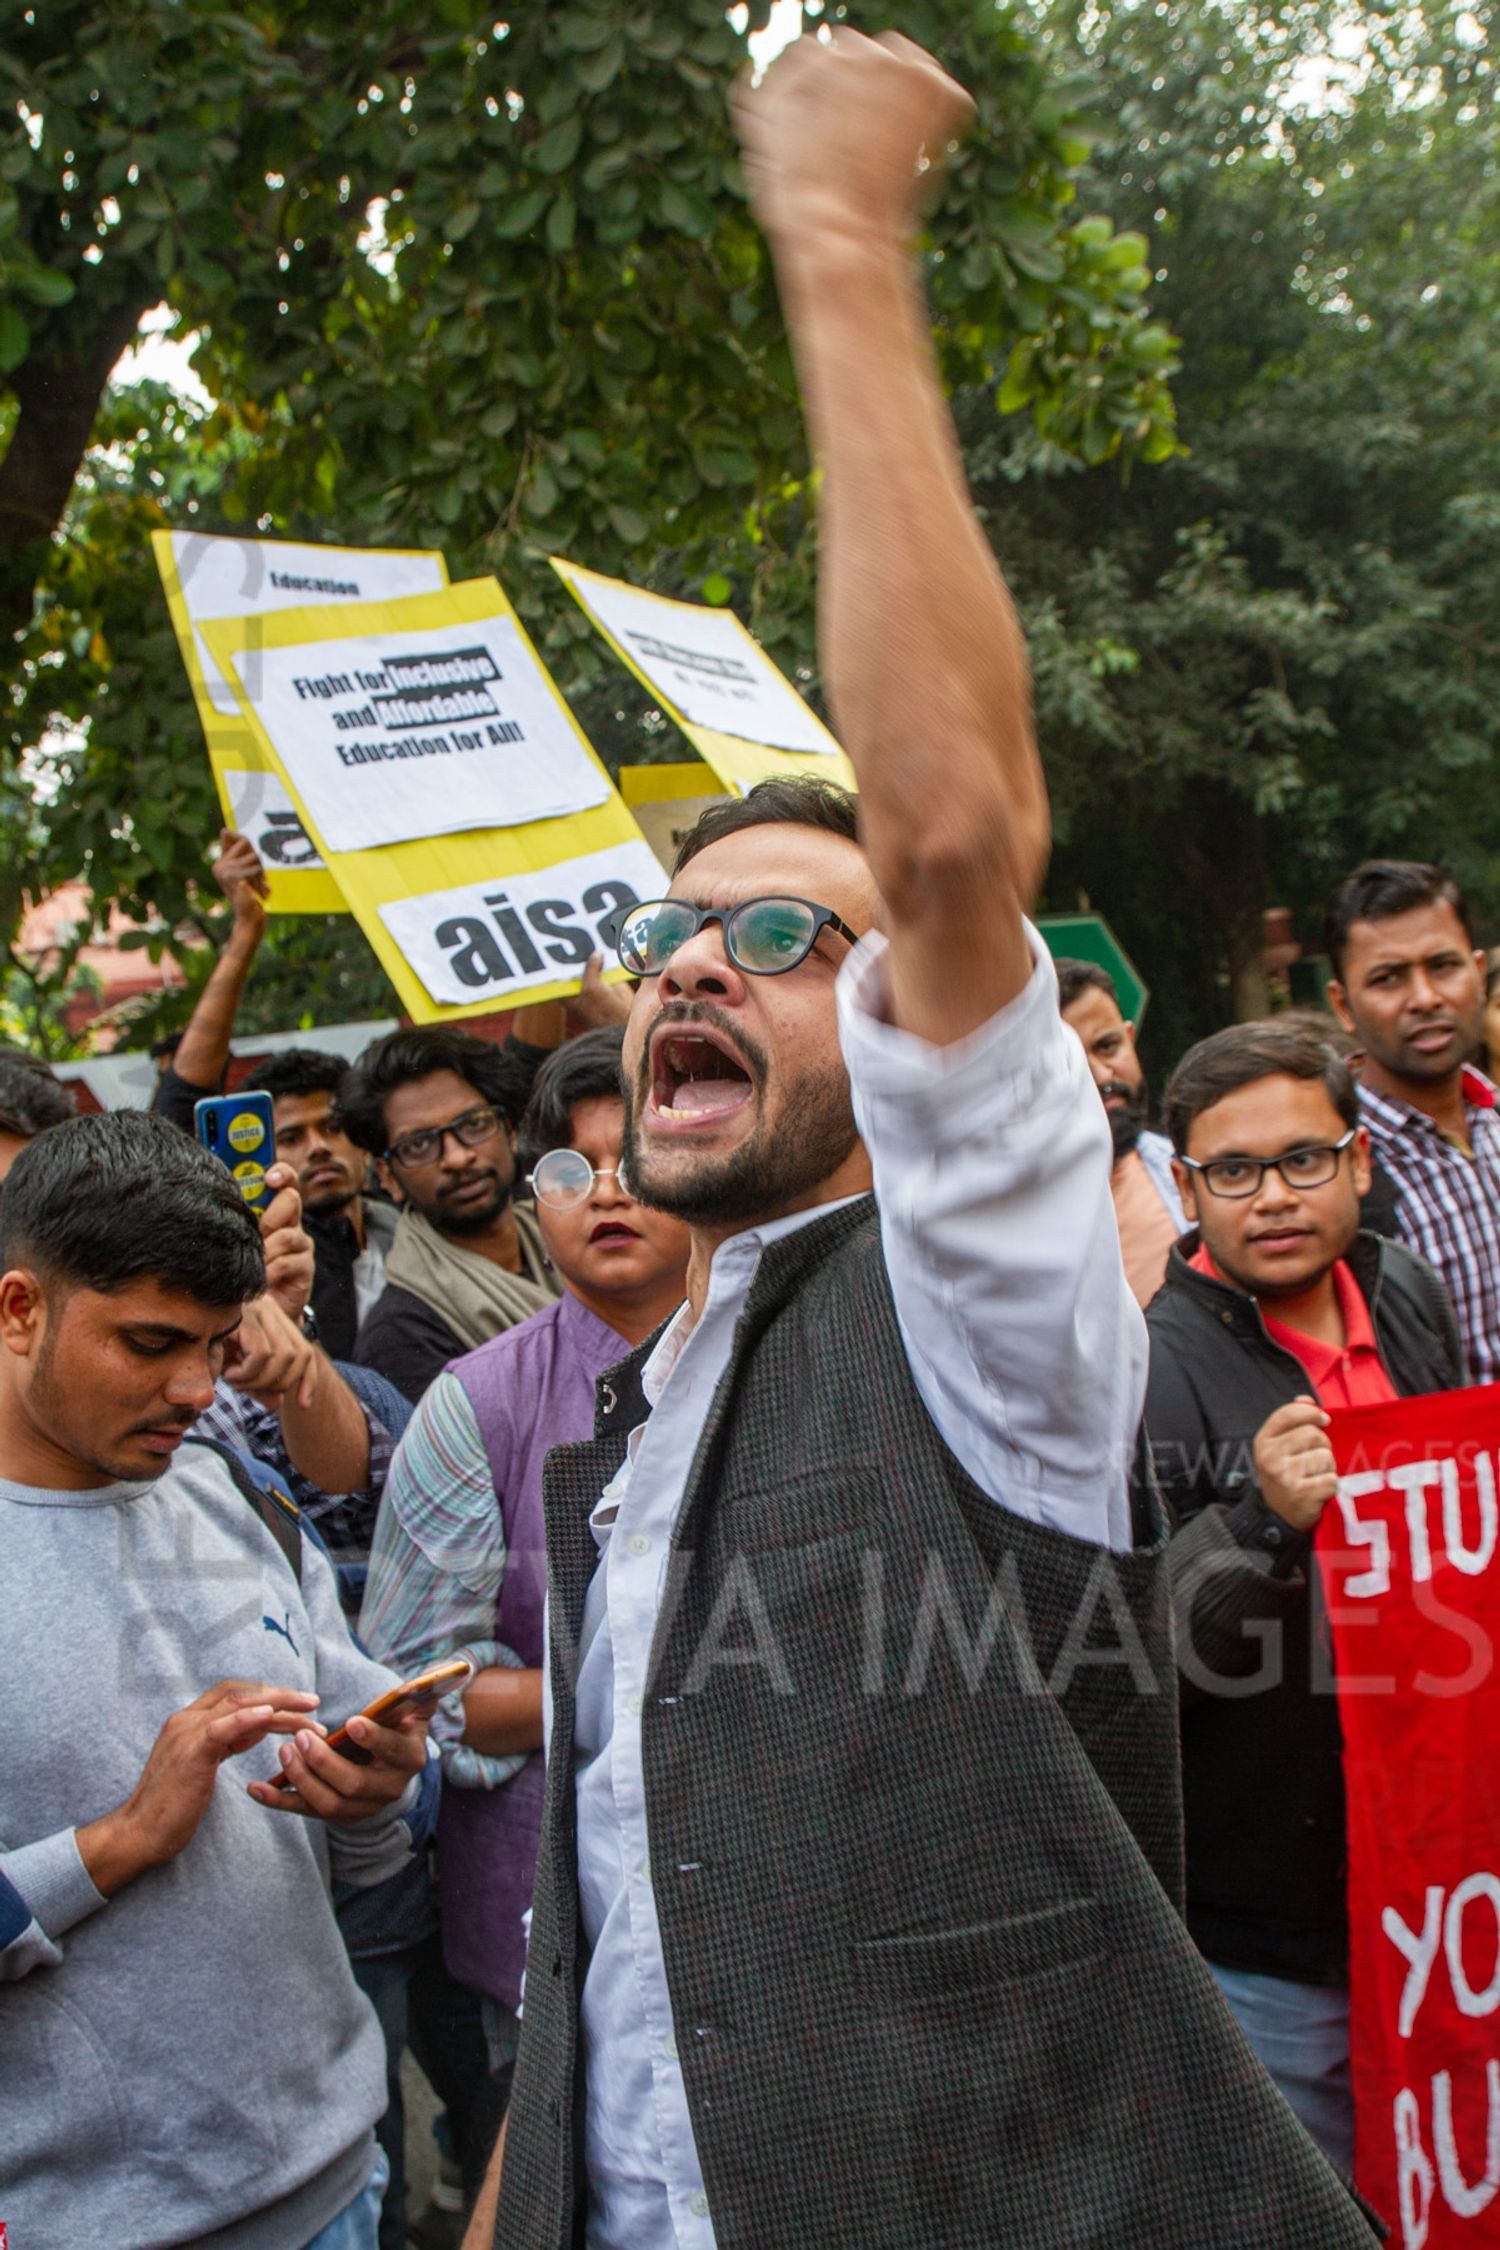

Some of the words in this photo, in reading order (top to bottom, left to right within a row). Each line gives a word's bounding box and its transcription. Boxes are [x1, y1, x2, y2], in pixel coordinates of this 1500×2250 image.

[269, 571, 361, 596] Education
[292, 671, 356, 700] Fight
[354, 669, 389, 691] for
[386, 654, 498, 690] Inclusive
[331, 703, 379, 731] and
[377, 689, 498, 728] Affordable
[335, 735, 451, 767] Education
[449, 729, 485, 751] for
[485, 721, 527, 745] All!
[435, 880, 642, 988] aisa
[1335, 1448, 1500, 1599] STU
[1382, 1871, 1500, 2038] YO
[1393, 2058, 1500, 2250] BU
